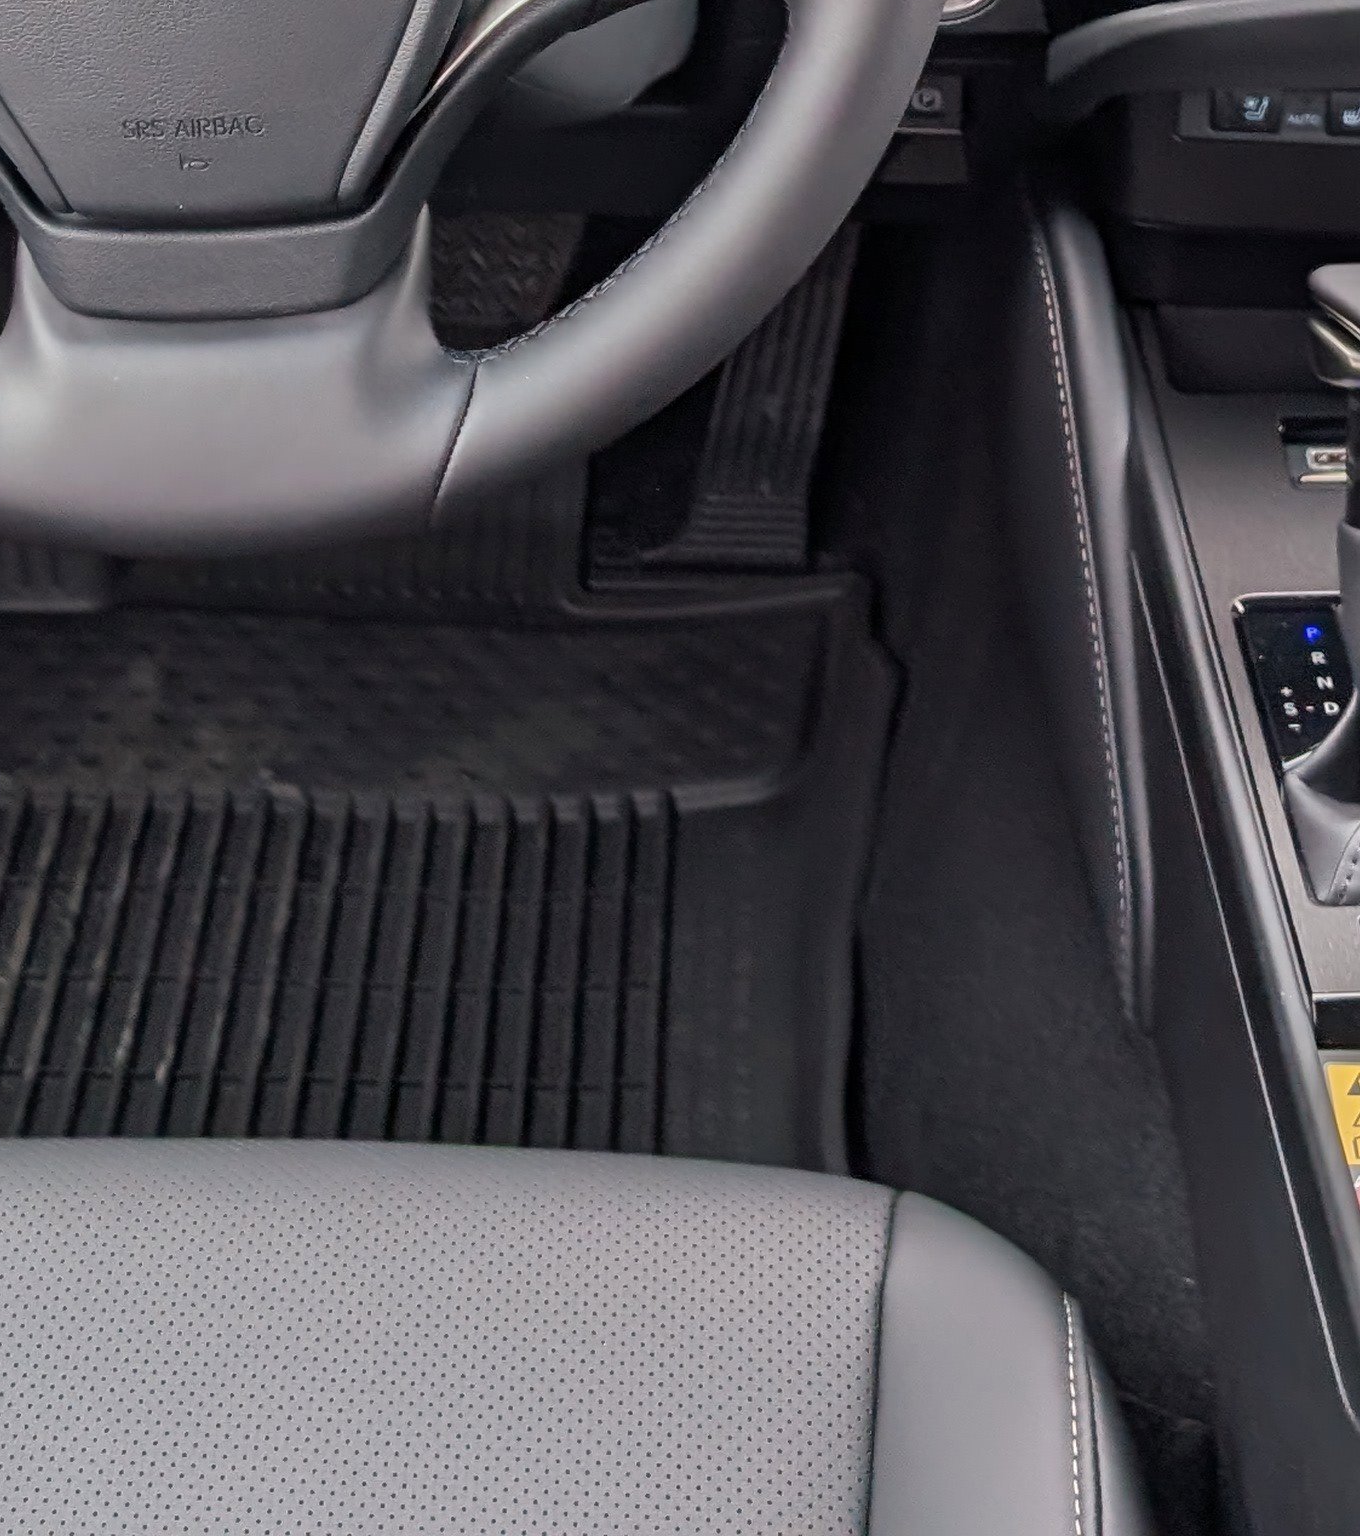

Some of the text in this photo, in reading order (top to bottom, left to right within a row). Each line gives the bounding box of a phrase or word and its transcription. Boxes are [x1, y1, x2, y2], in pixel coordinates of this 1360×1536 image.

[121, 119, 165, 140] SRS
[1310, 651, 1327, 665] R
[1316, 675, 1334, 690] N
